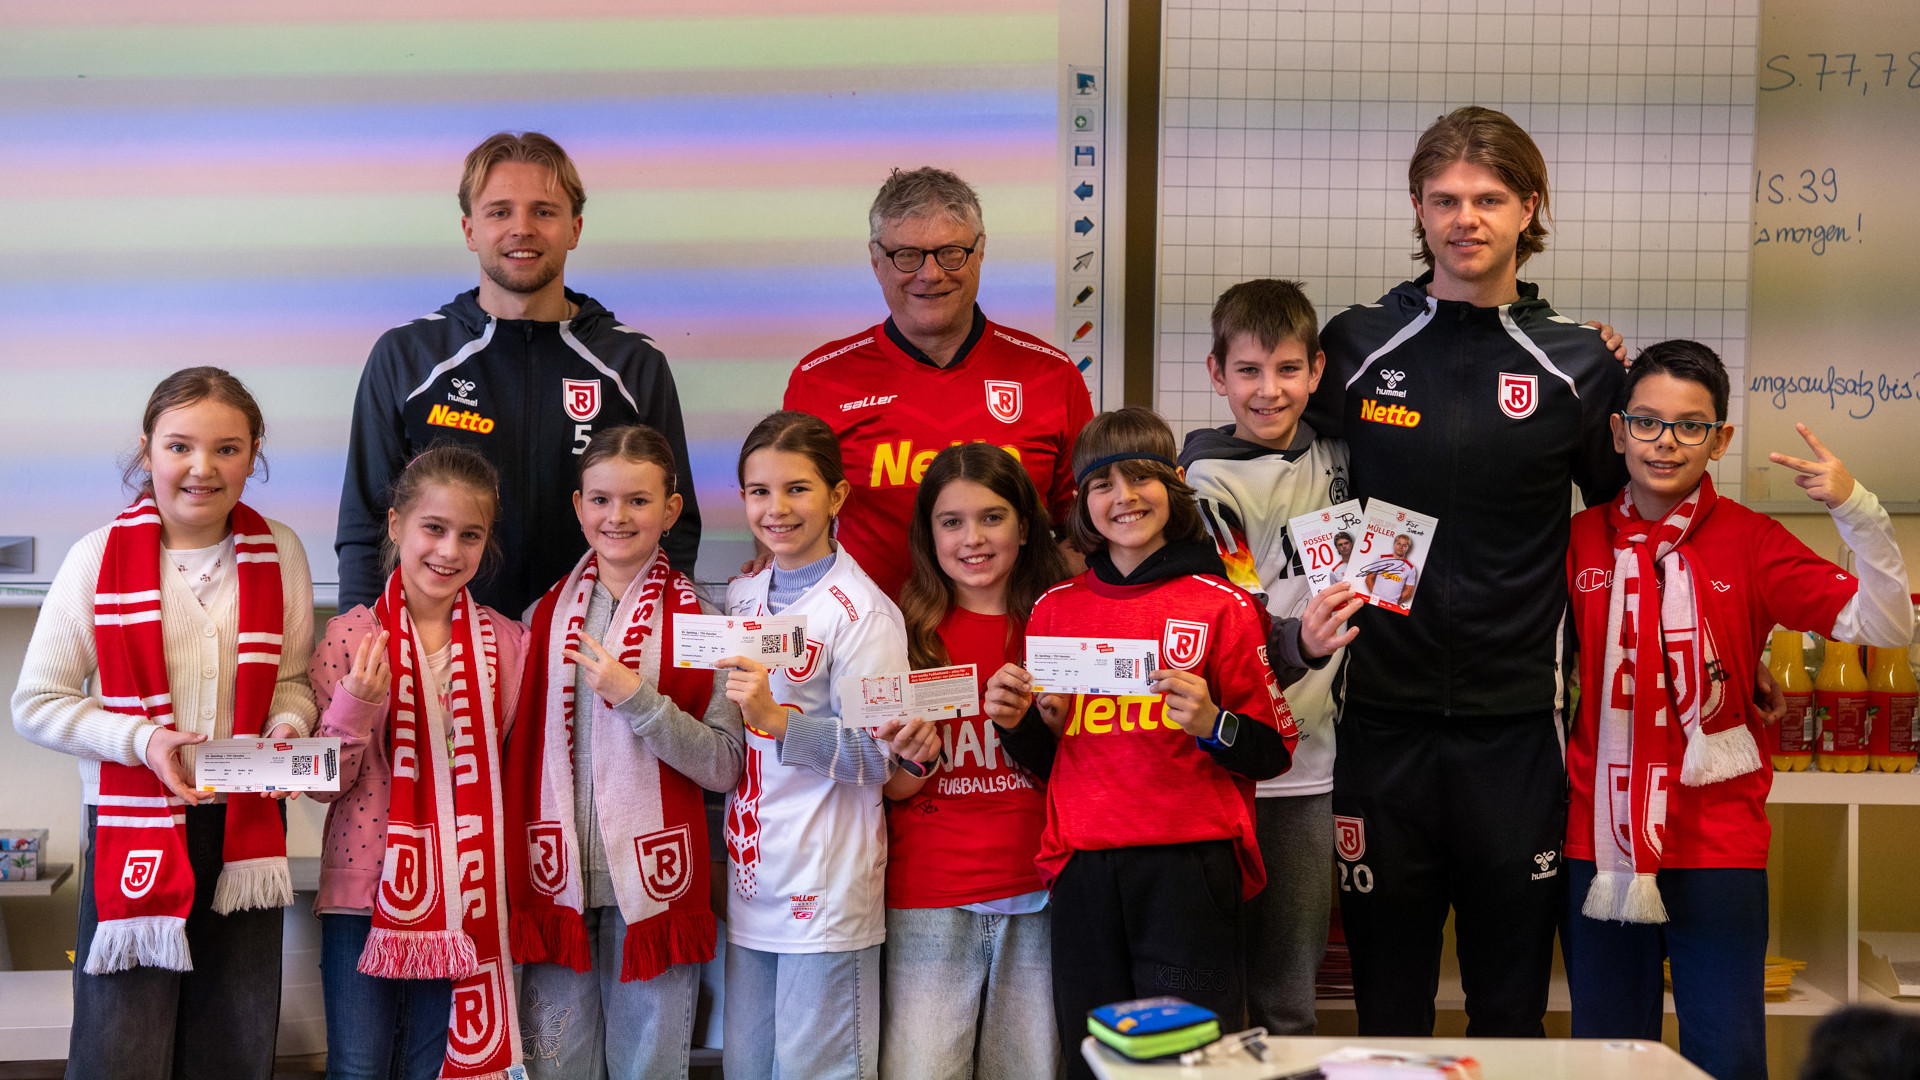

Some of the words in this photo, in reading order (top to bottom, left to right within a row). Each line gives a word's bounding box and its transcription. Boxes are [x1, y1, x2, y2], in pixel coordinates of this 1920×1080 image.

[447, 392, 478, 407] hummel
[1375, 386, 1407, 398] hummel
[426, 404, 495, 434] Netto
[1360, 398, 1421, 428] Netto
[571, 424, 592, 455] 5
[1303, 532, 1334, 547] POSSELT
[1359, 531, 1375, 554] 5
[1366, 523, 1396, 539] MÜLLER
[1306, 543, 1334, 570] 20
[1337, 861, 1374, 893] 20
[1531, 866, 1557, 880] hummel
[1156, 963, 1227, 991] KENZO
